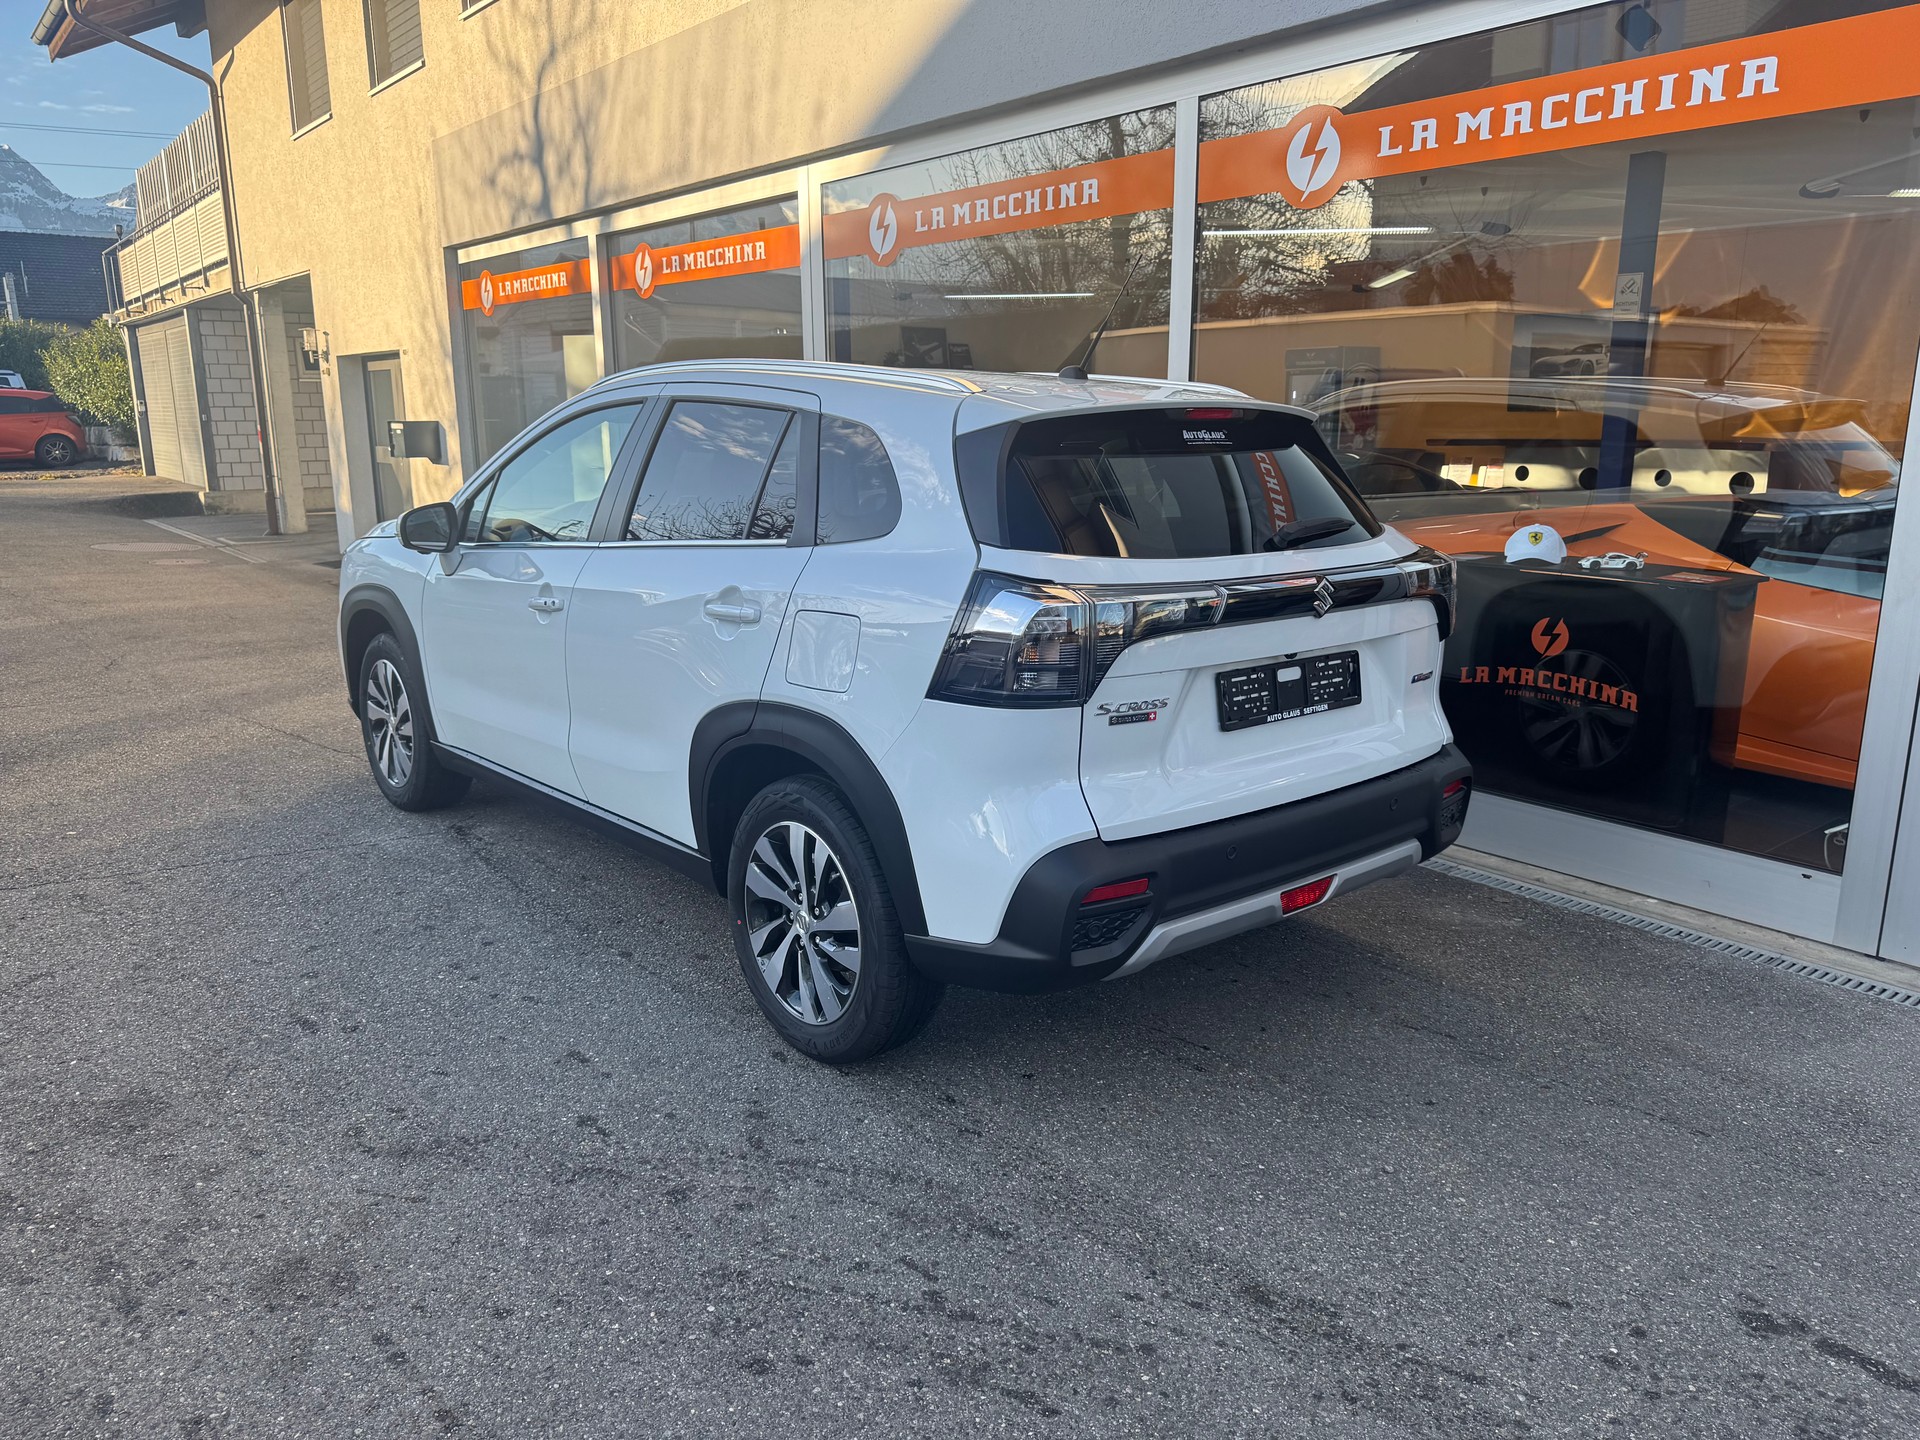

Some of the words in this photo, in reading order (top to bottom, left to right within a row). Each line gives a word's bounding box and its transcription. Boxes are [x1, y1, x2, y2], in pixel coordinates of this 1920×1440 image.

[1377, 118, 1438, 157] LA
[1453, 56, 1780, 145] MACCHINA
[915, 207, 945, 232] LA
[952, 178, 1099, 226] MACCHINA
[662, 255, 680, 274] LA
[683, 241, 766, 271] MACCHINA
[499, 281, 512, 296] LA
[513, 271, 568, 294] MACCHINA
[1459, 666, 1490, 684] LA
[1496, 666, 1638, 713] MACCHINA
[1504, 689, 1535, 699] PREMIUM
[1537, 692, 1561, 703] DREAM
[1562, 696, 1581, 708] CARS
[1267, 713, 1282, 722] AUTO
[1283, 709, 1300, 719] GLAUS
[1303, 703, 1329, 714] SEFTIGEN
